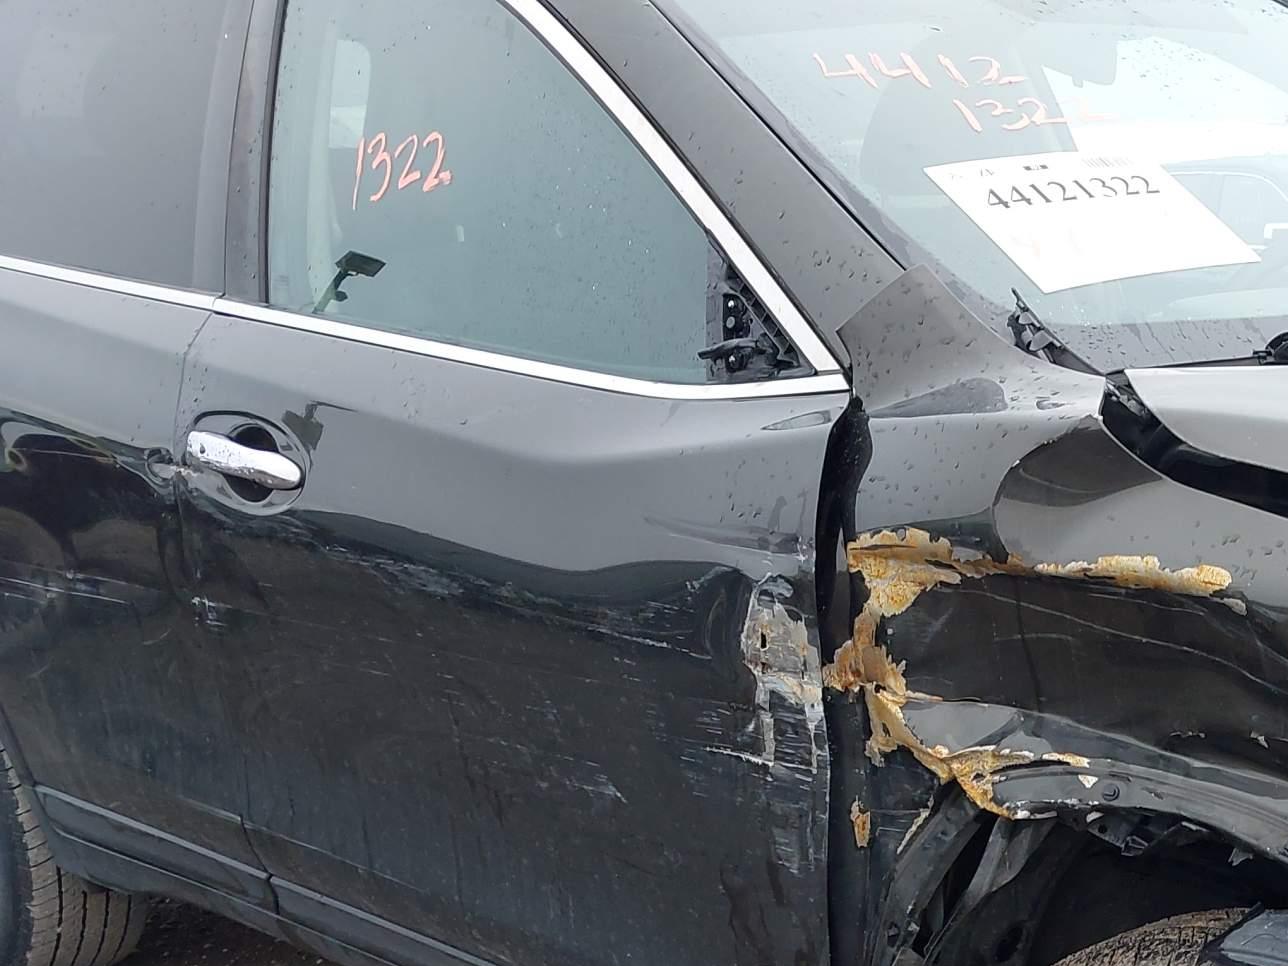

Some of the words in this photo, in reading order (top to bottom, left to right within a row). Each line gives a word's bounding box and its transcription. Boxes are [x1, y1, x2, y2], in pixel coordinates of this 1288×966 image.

[813, 53, 1027, 89] 4412
[352, 131, 452, 210] 1322
[986, 175, 1160, 209] 44121322
